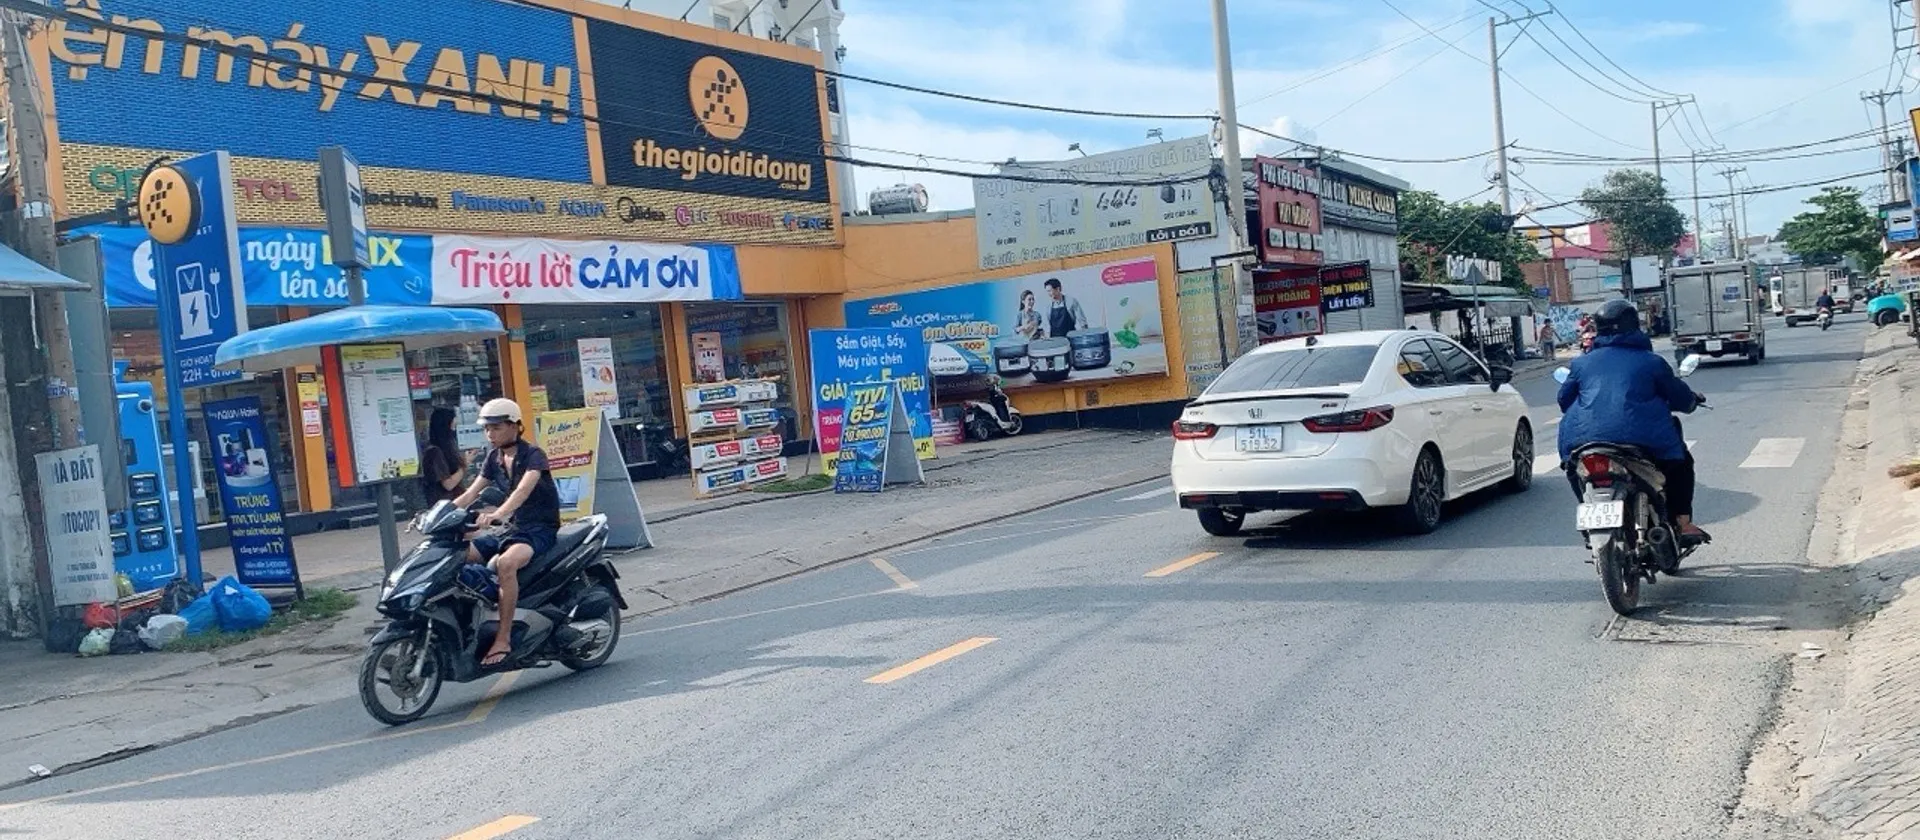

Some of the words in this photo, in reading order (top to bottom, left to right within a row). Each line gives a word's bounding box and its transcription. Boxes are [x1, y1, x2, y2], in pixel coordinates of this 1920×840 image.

[180, 23, 359, 113] máy
[357, 36, 572, 125] XANH
[632, 138, 812, 191] thegioididong
[1148, 145, 1178, 169] GIÁ
[238, 178, 299, 201] TCL
[451, 190, 546, 214] Panasonic
[1149, 228, 1169, 240] LỖI
[1178, 223, 1199, 237] ĐỔI
[246, 232, 318, 271] ngày
[450, 248, 533, 299] Triệu
[540, 252, 574, 288] lời
[579, 244, 650, 289] CẢM
[656, 255, 699, 288] ƠN
[280, 270, 319, 298] lên
[1256, 293, 1275, 305] HUY
[859, 335, 885, 352] Giặt,
[886, 333, 907, 350] Sấy,
[837, 354, 860, 370] Máy
[880, 353, 903, 365] chén
[854, 385, 888, 405] TIVI
[849, 403, 875, 425] 65
[1240, 438, 1278, 451] 519.52
[1249, 427, 1269, 439] 51L
[70, 450, 95, 482] ĐẤT
